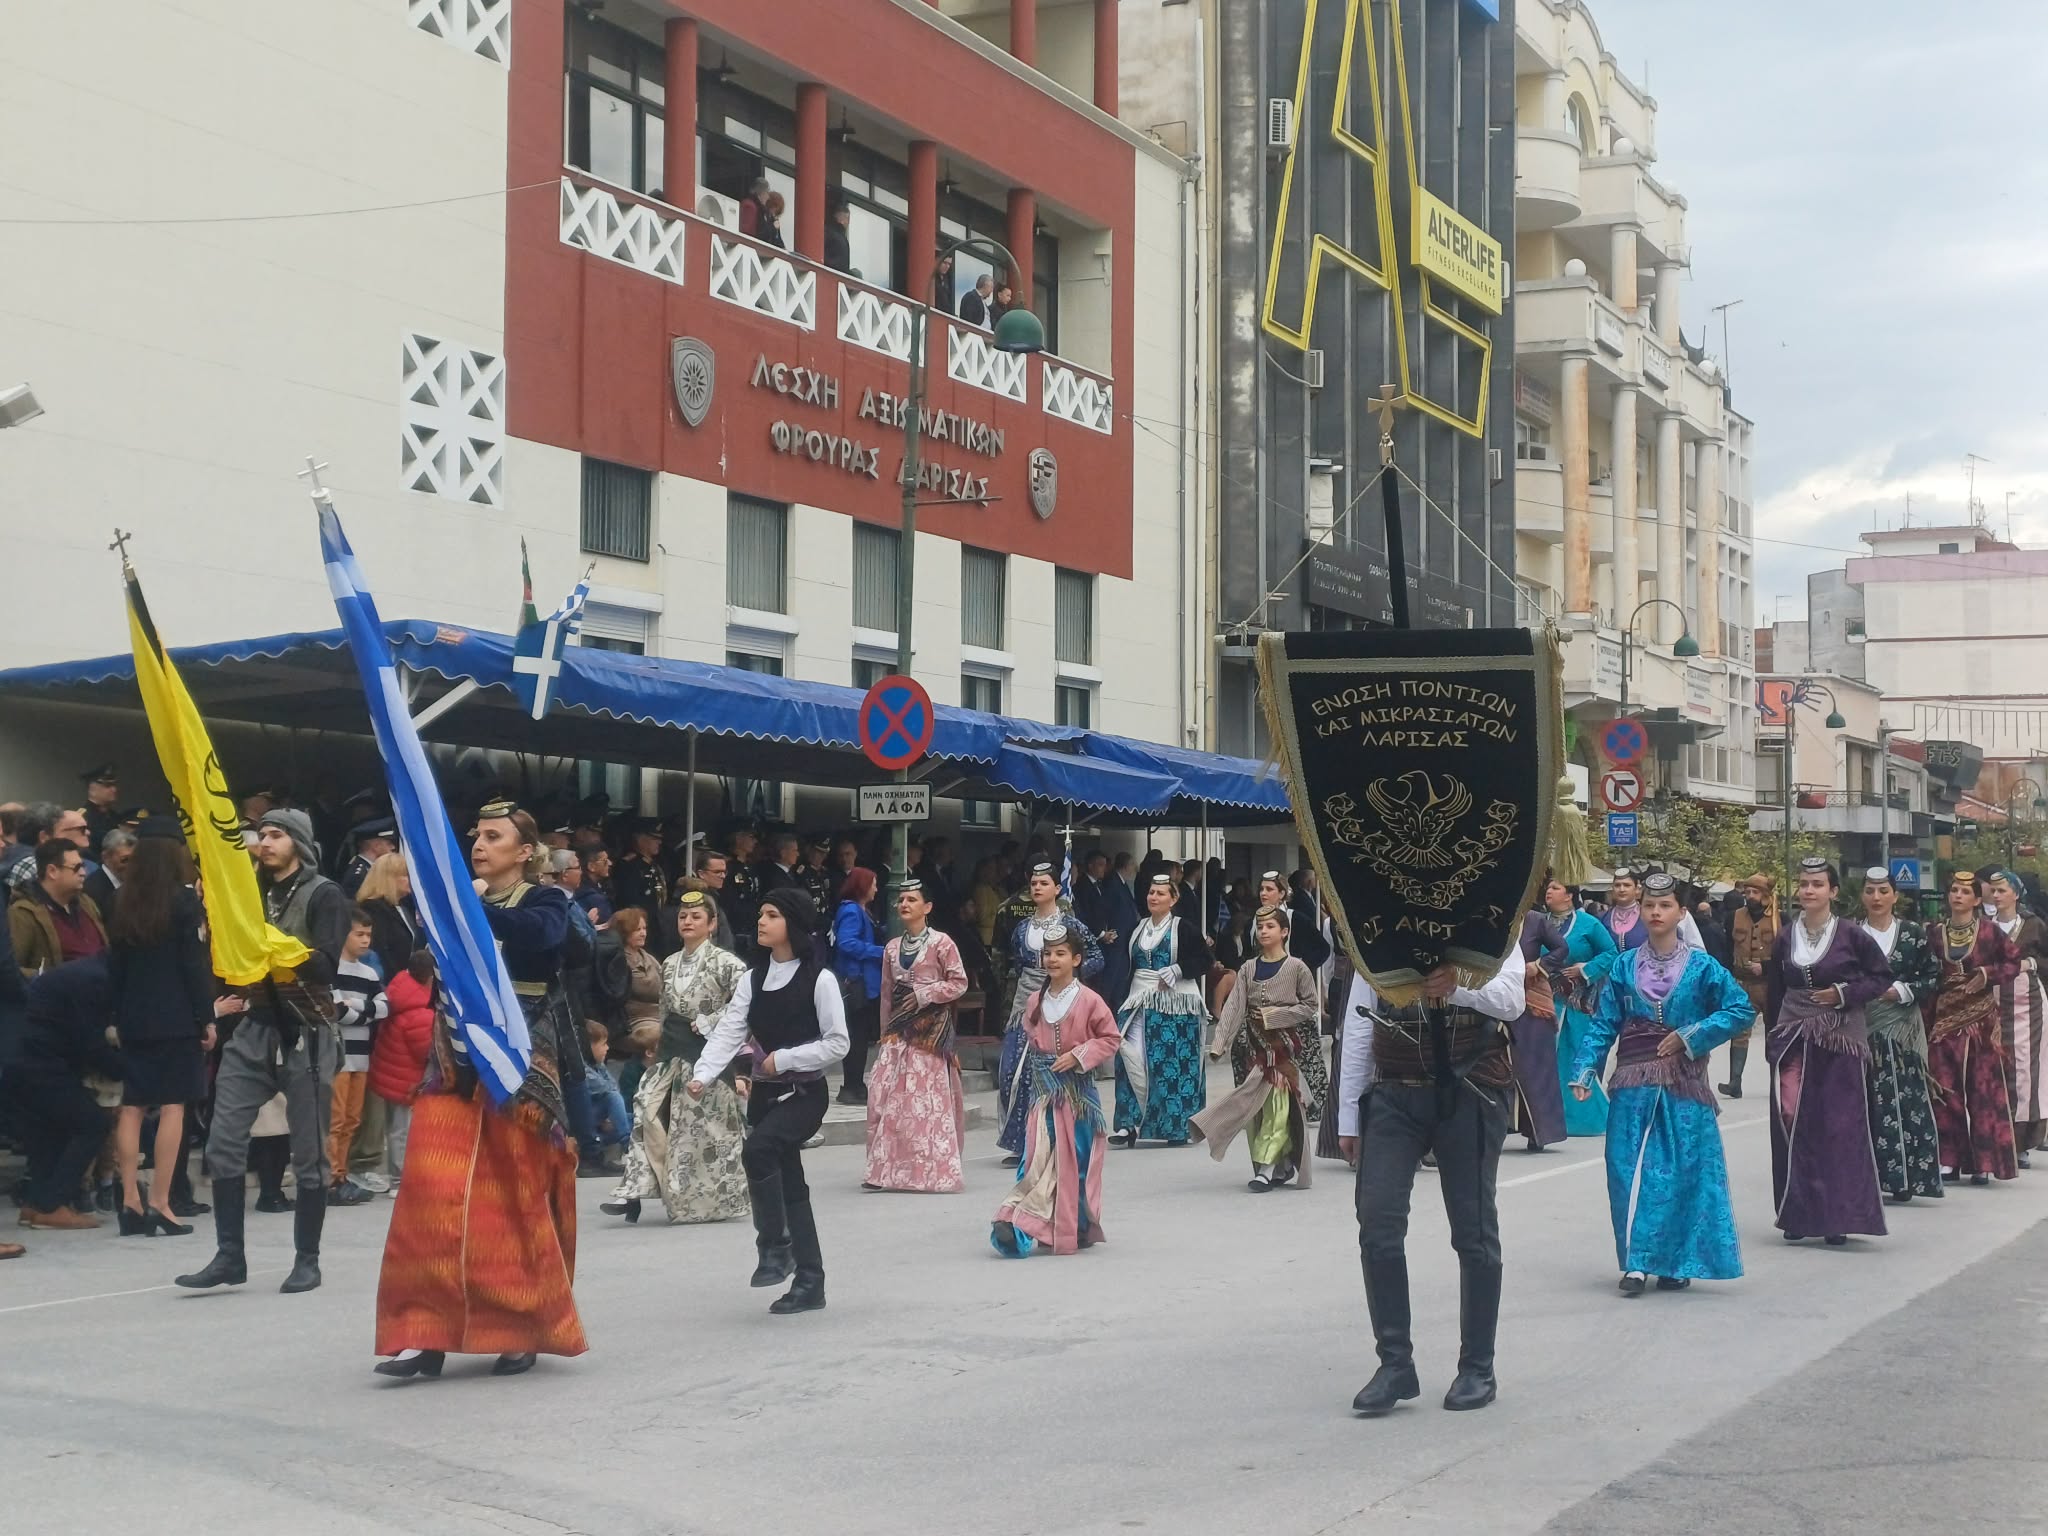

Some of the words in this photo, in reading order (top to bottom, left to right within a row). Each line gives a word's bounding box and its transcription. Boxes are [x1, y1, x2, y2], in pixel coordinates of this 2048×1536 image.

[1428, 207, 1496, 280] ALTERLIFE
[1428, 246, 1455, 272] FITNESS
[1457, 265, 1496, 299] EXCELLENCE
[750, 352, 839, 409] ΛΕΣΧΗ
[771, 420, 880, 479] ΦΡΟΥΡΑΣ
[1311, 682, 1391, 716] ΕΝΩΣΗ
[1400, 680, 1516, 718] ΠΟΝΤΙΩΝ
[1314, 716, 1352, 739] ΚΑΙ
[1360, 706, 1517, 743] ΜΙΚΡΑΣΙΑΤΩΝ
[1362, 730, 1469, 747] ΛΑΡΙΣΑΣ
[874, 801, 925, 814] ΛΑΦΛ
